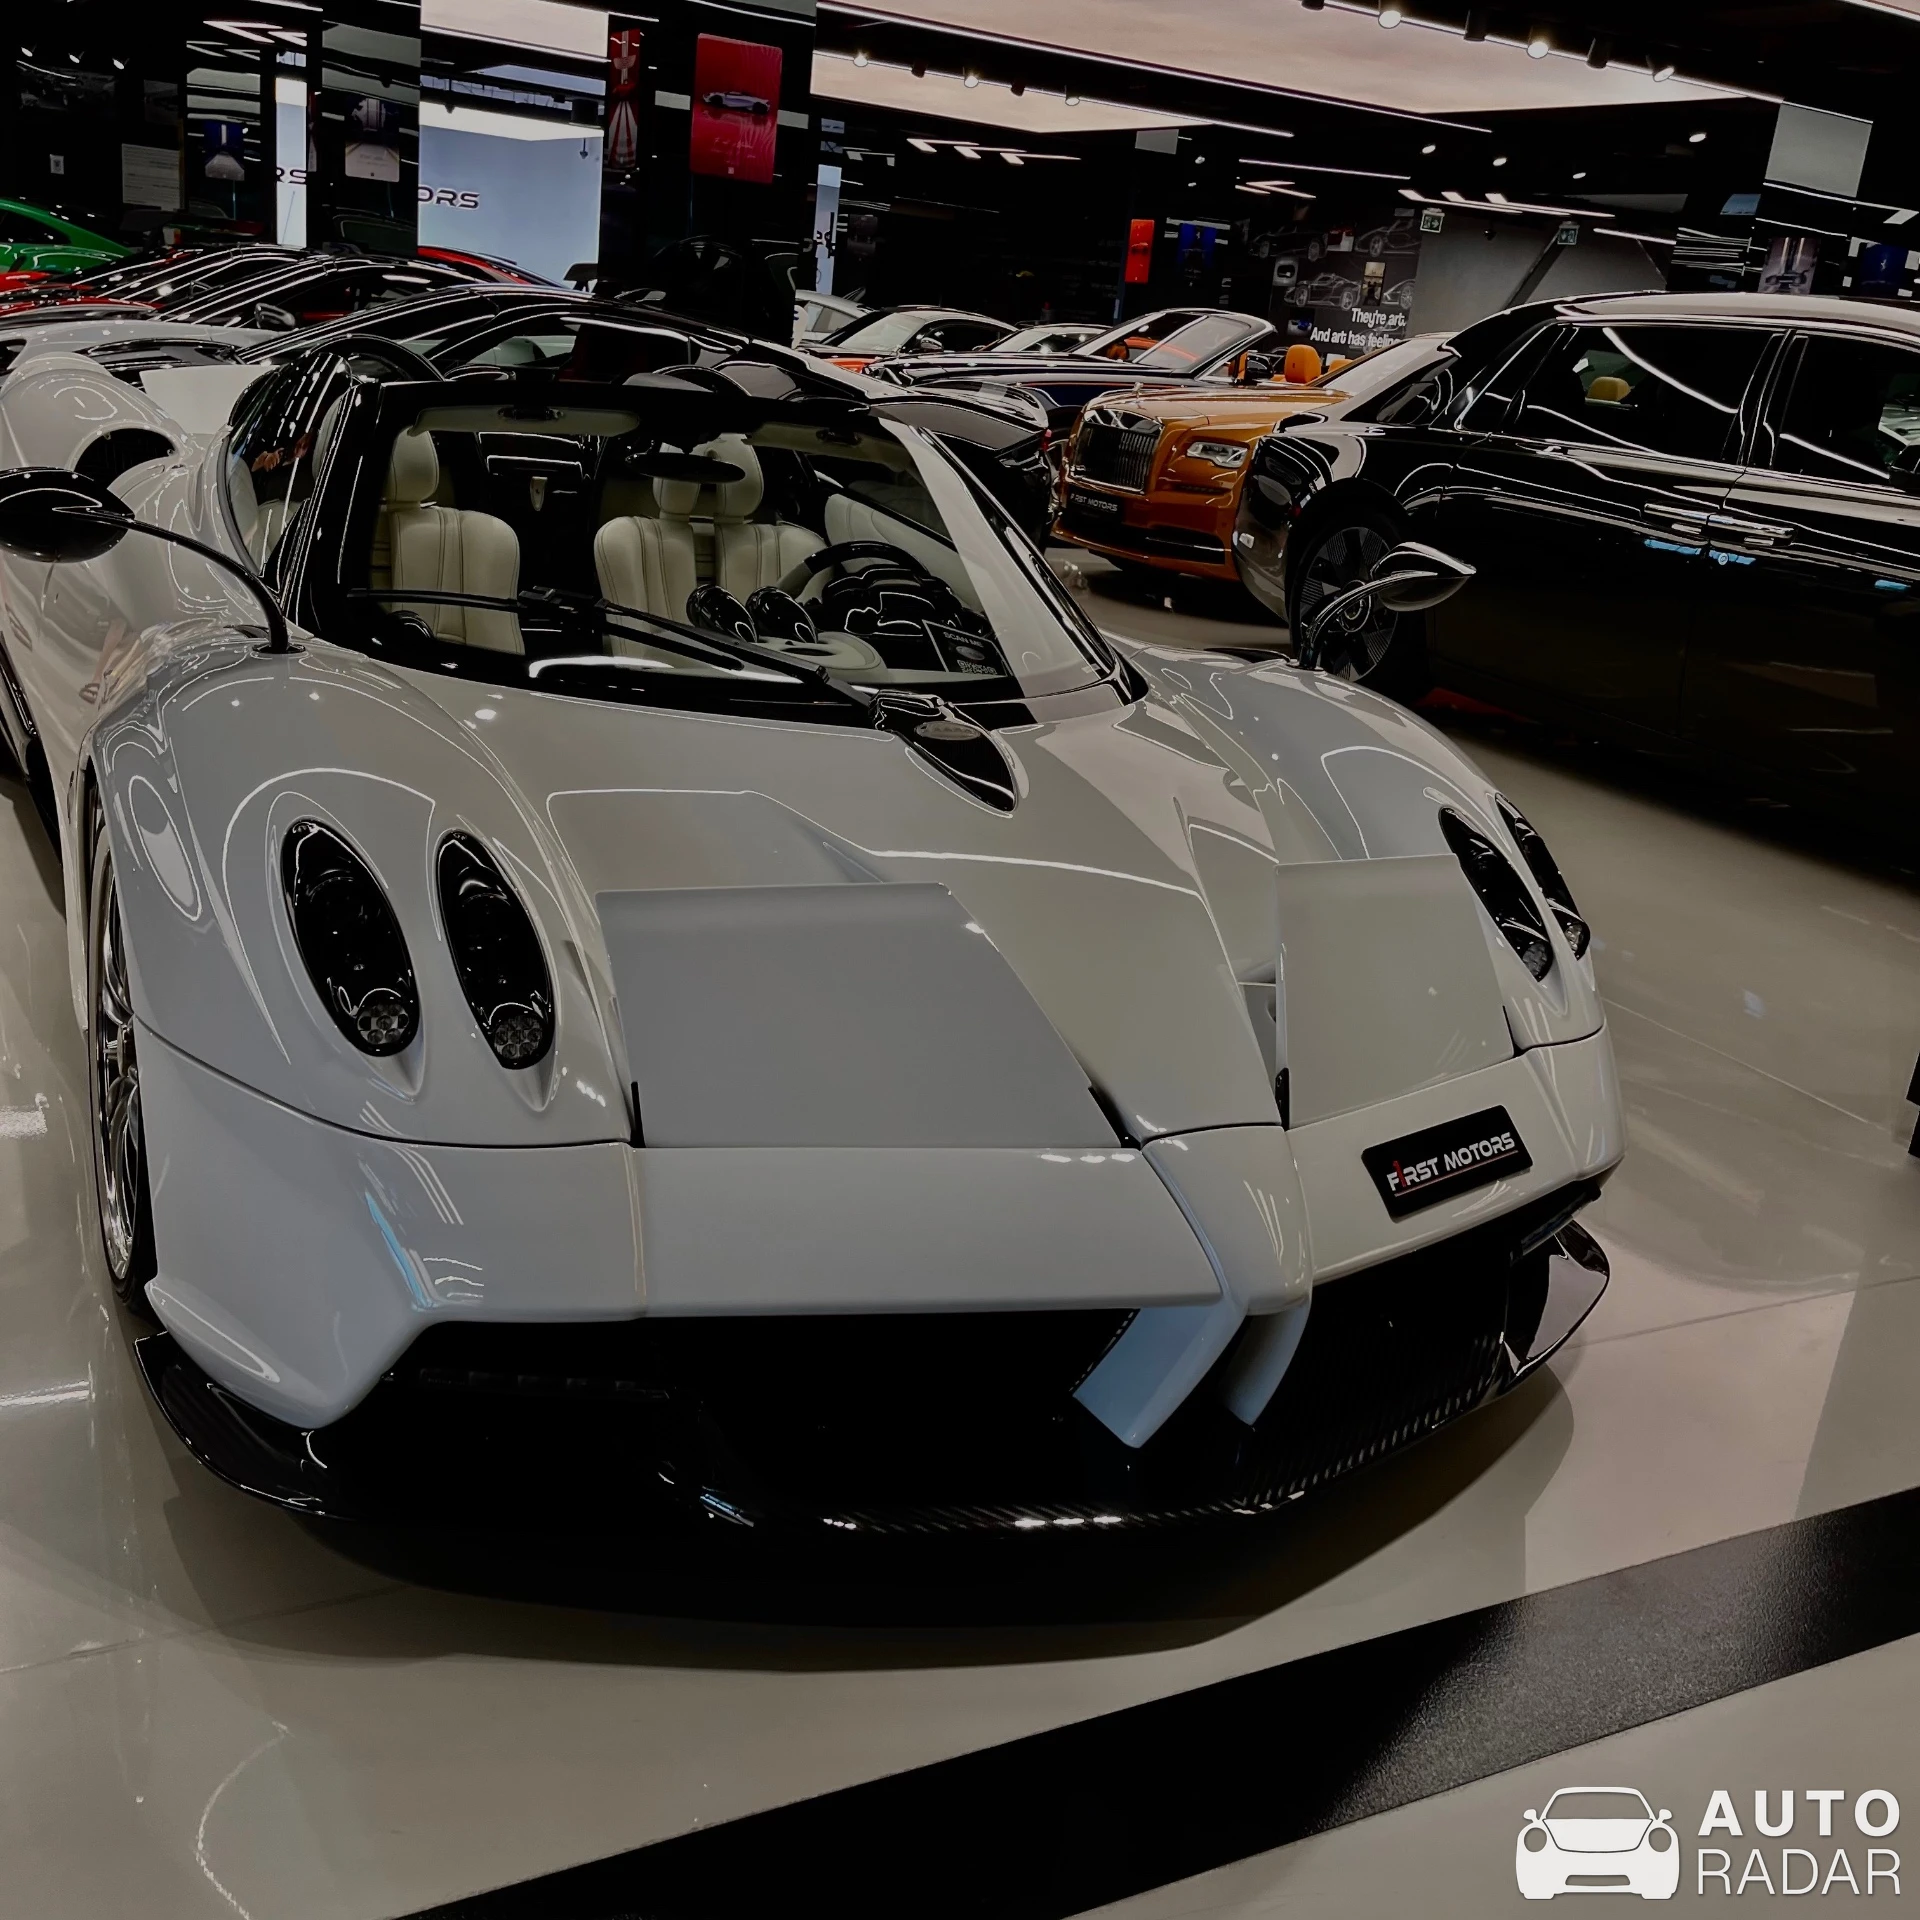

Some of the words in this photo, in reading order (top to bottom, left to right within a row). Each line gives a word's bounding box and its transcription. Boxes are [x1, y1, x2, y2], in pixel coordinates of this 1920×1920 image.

[1351, 307, 1386, 328] They're
[1310, 326, 1331, 343] And
[1331, 329, 1347, 345] art
[1347, 330, 1366, 346] has
[1087, 498, 1118, 512] MOTORS
[1444, 1132, 1516, 1172] MOTORS
